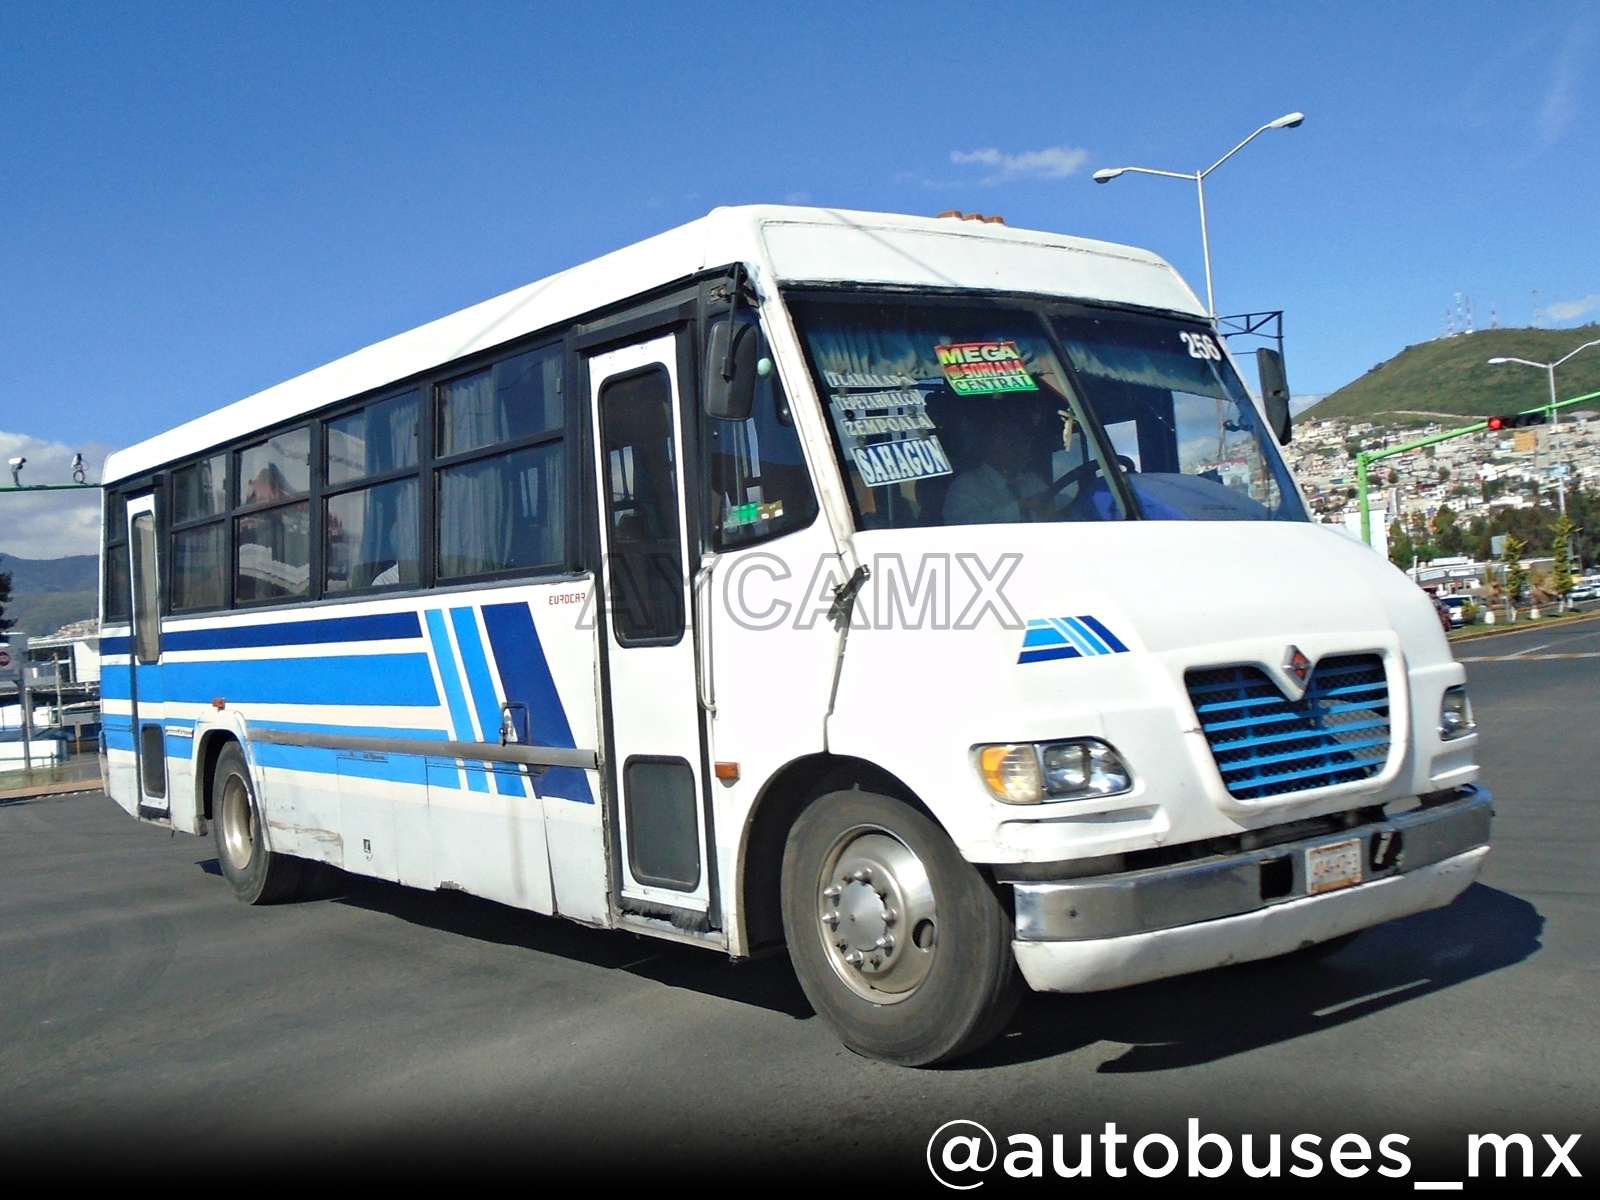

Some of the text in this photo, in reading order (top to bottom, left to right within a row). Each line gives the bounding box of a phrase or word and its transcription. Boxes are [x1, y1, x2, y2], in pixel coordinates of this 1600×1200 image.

[938, 345, 1020, 365] MEGA
[1179, 331, 1222, 361] 256
[961, 360, 1028, 378] SORIANA
[955, 375, 1034, 392] CENTRAL
[845, 416, 931, 436] ZEMPOALA
[856, 438, 949, 483] SAHAGUN
[549, 592, 586, 605] EUROCAR
